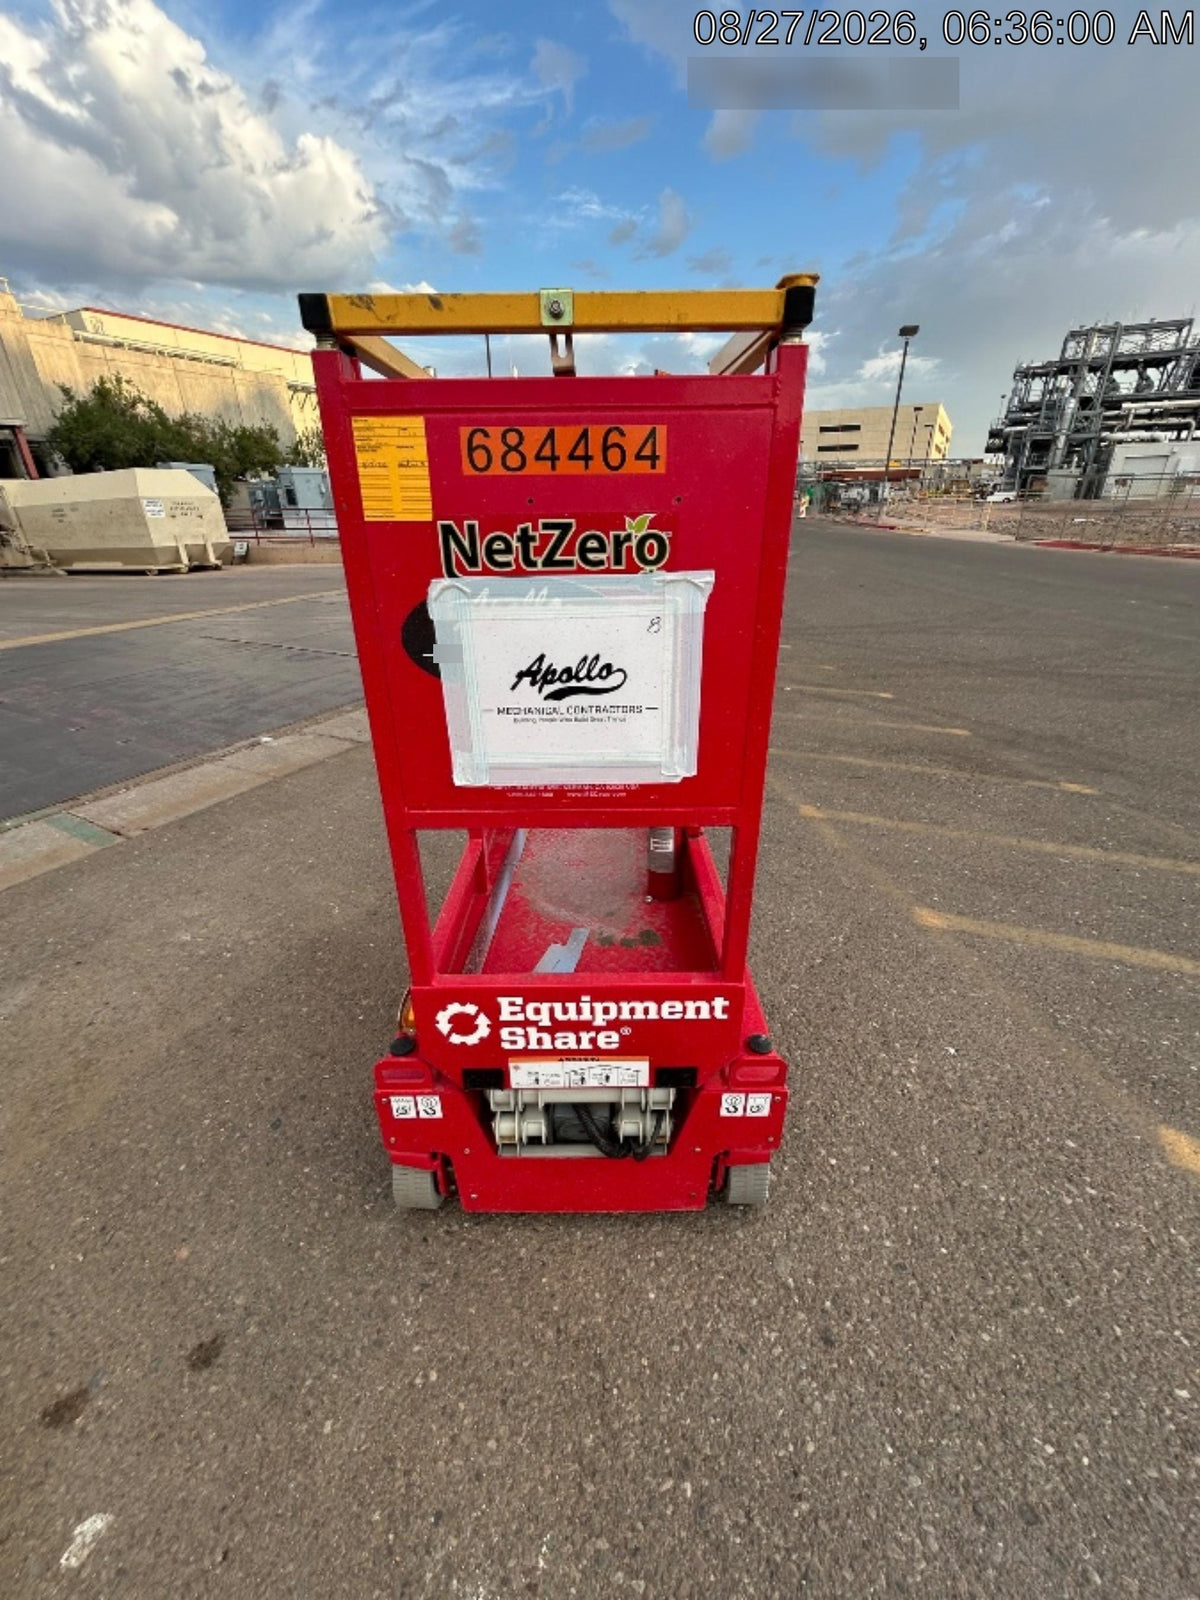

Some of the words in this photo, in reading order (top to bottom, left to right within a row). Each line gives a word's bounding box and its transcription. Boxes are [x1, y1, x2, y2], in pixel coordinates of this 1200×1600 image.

[467, 426, 660, 472] 684464
[438, 520, 669, 578] NetZero
[646, 616, 662, 634] 8
[509, 653, 628, 701] Apollo
[496, 706, 564, 716] MECHANICAL
[567, 704, 643, 716] CONTRACTORS
[497, 995, 730, 1026] Equipment
